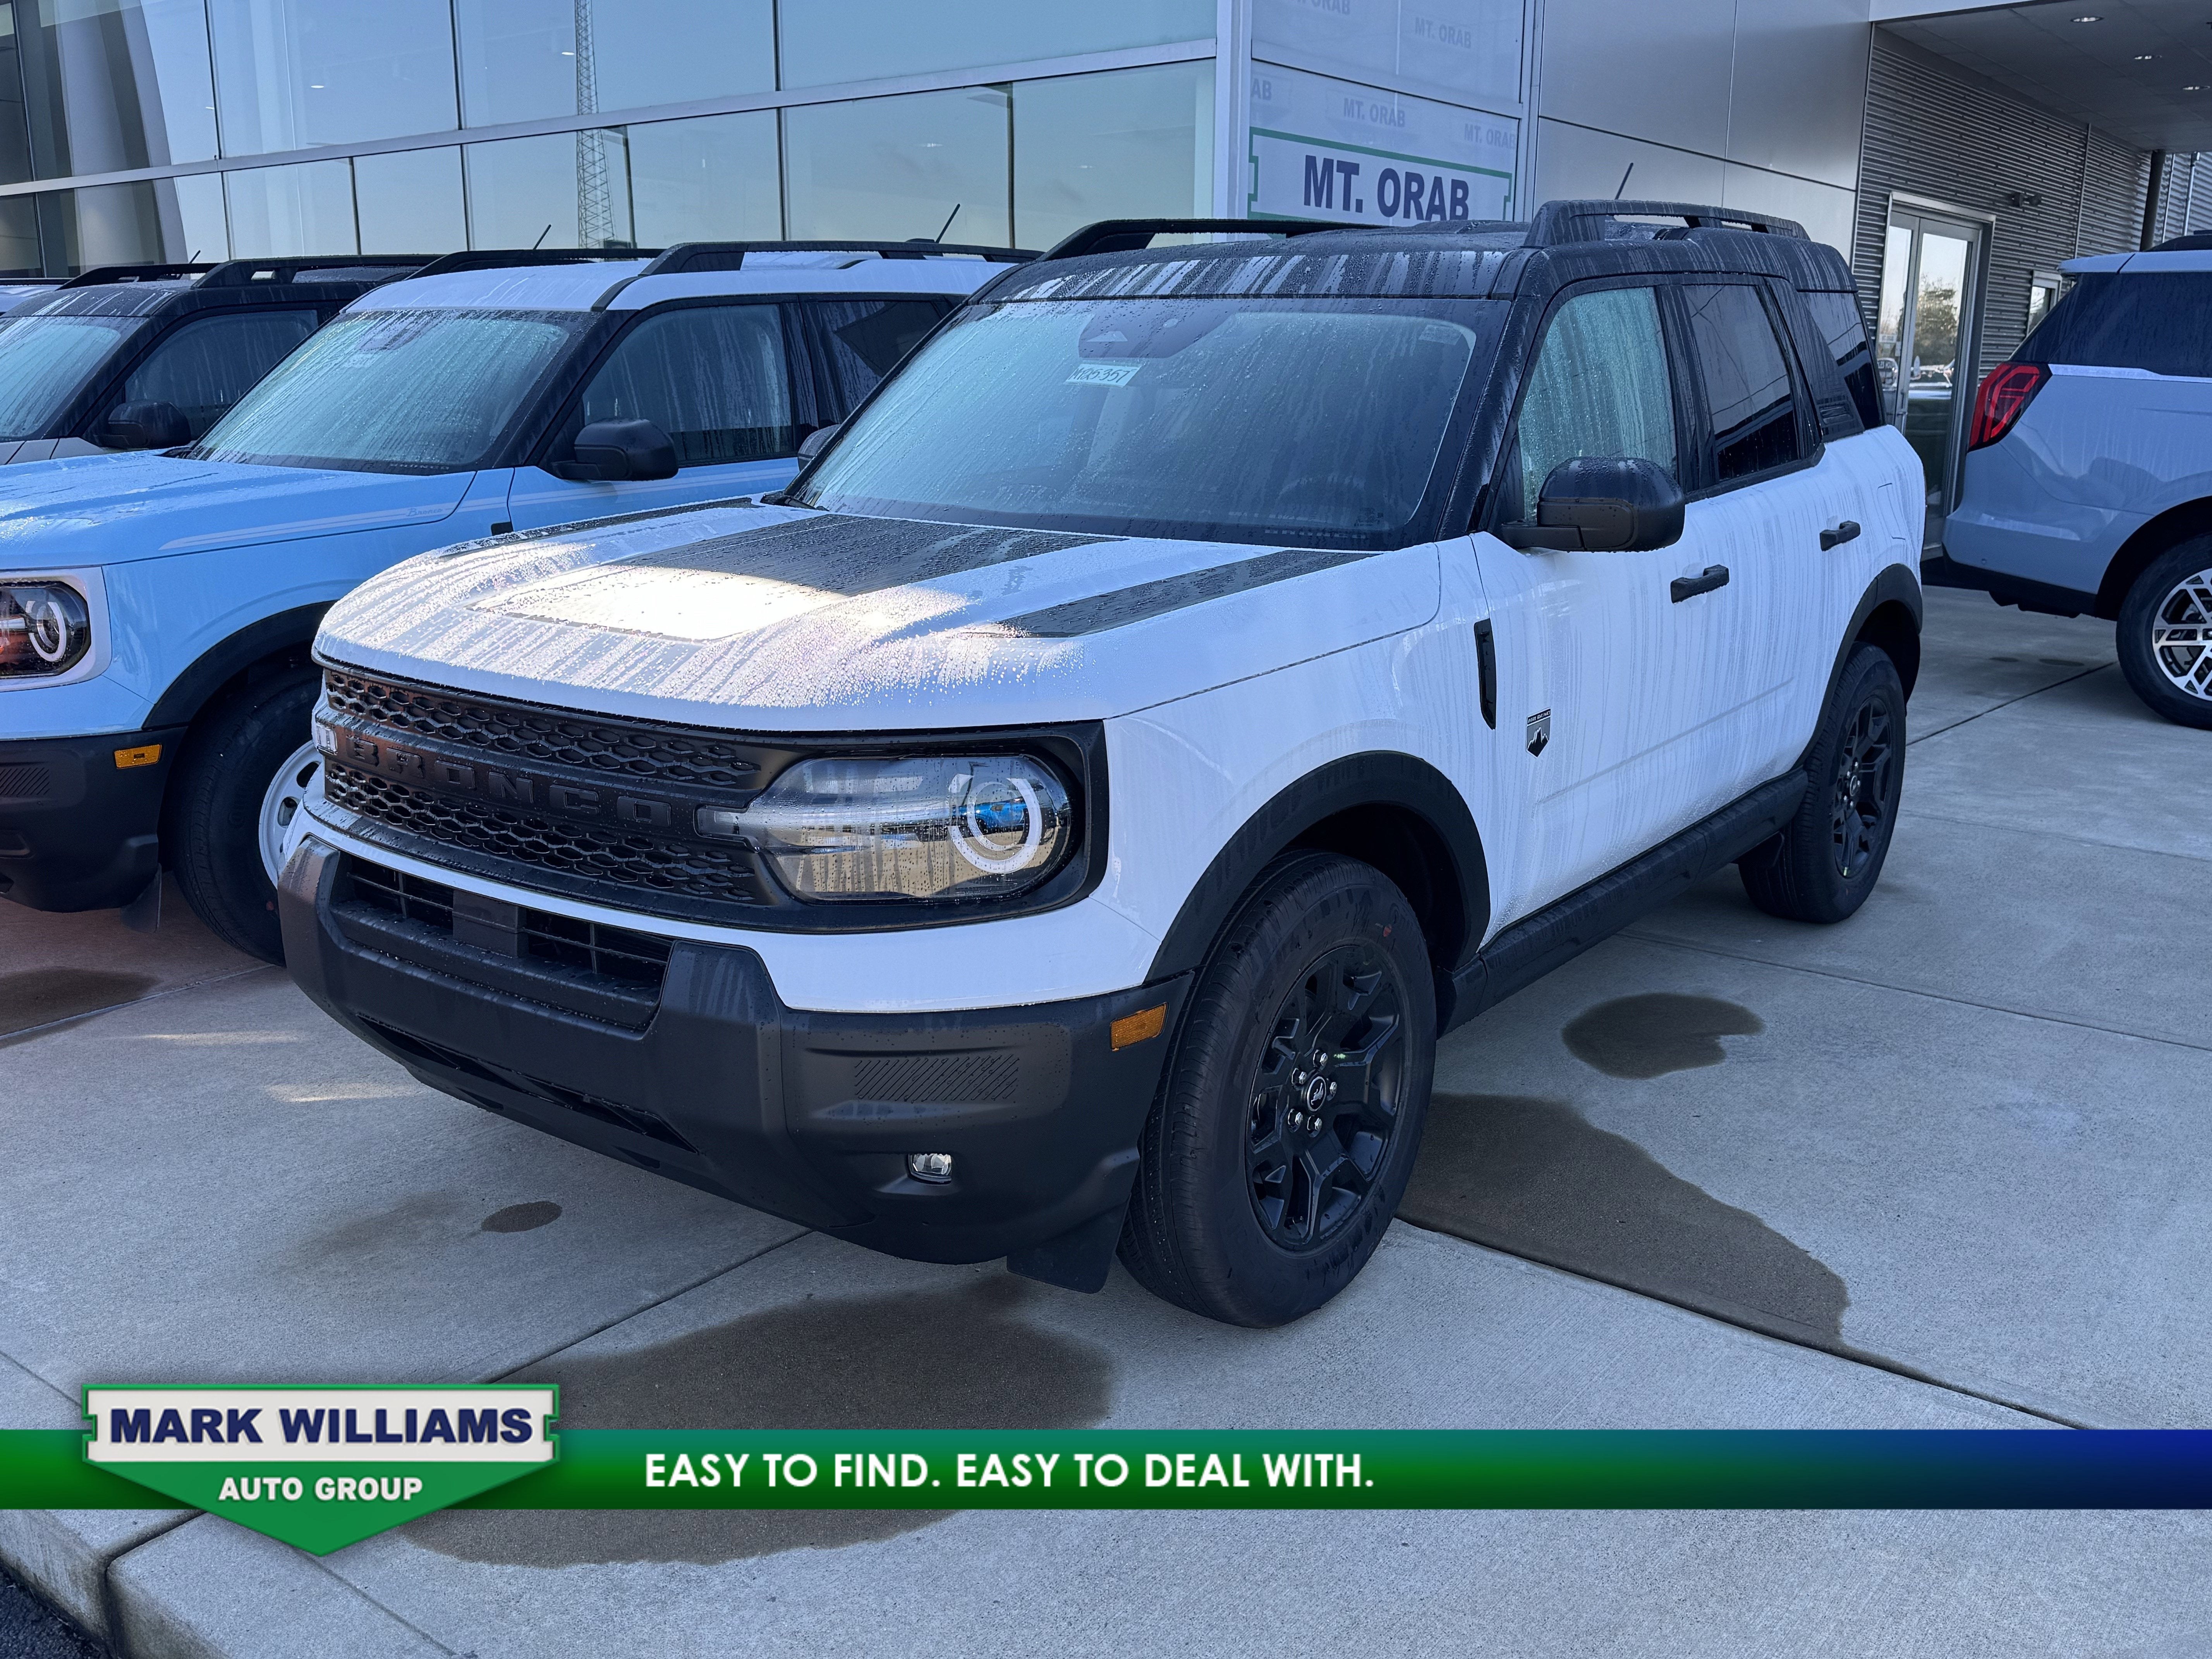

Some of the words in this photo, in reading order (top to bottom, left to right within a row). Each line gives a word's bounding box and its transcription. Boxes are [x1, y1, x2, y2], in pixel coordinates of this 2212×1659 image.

[1439, 24, 1472, 49] ORAB
[1343, 97, 1365, 120] MT.
[1369, 103, 1406, 128] ORAB
[1486, 129, 1516, 149] ORAB
[1304, 155, 1363, 213] MT.
[1377, 168, 1469, 221] ORAB
[345, 735, 672, 827] BRONCO
